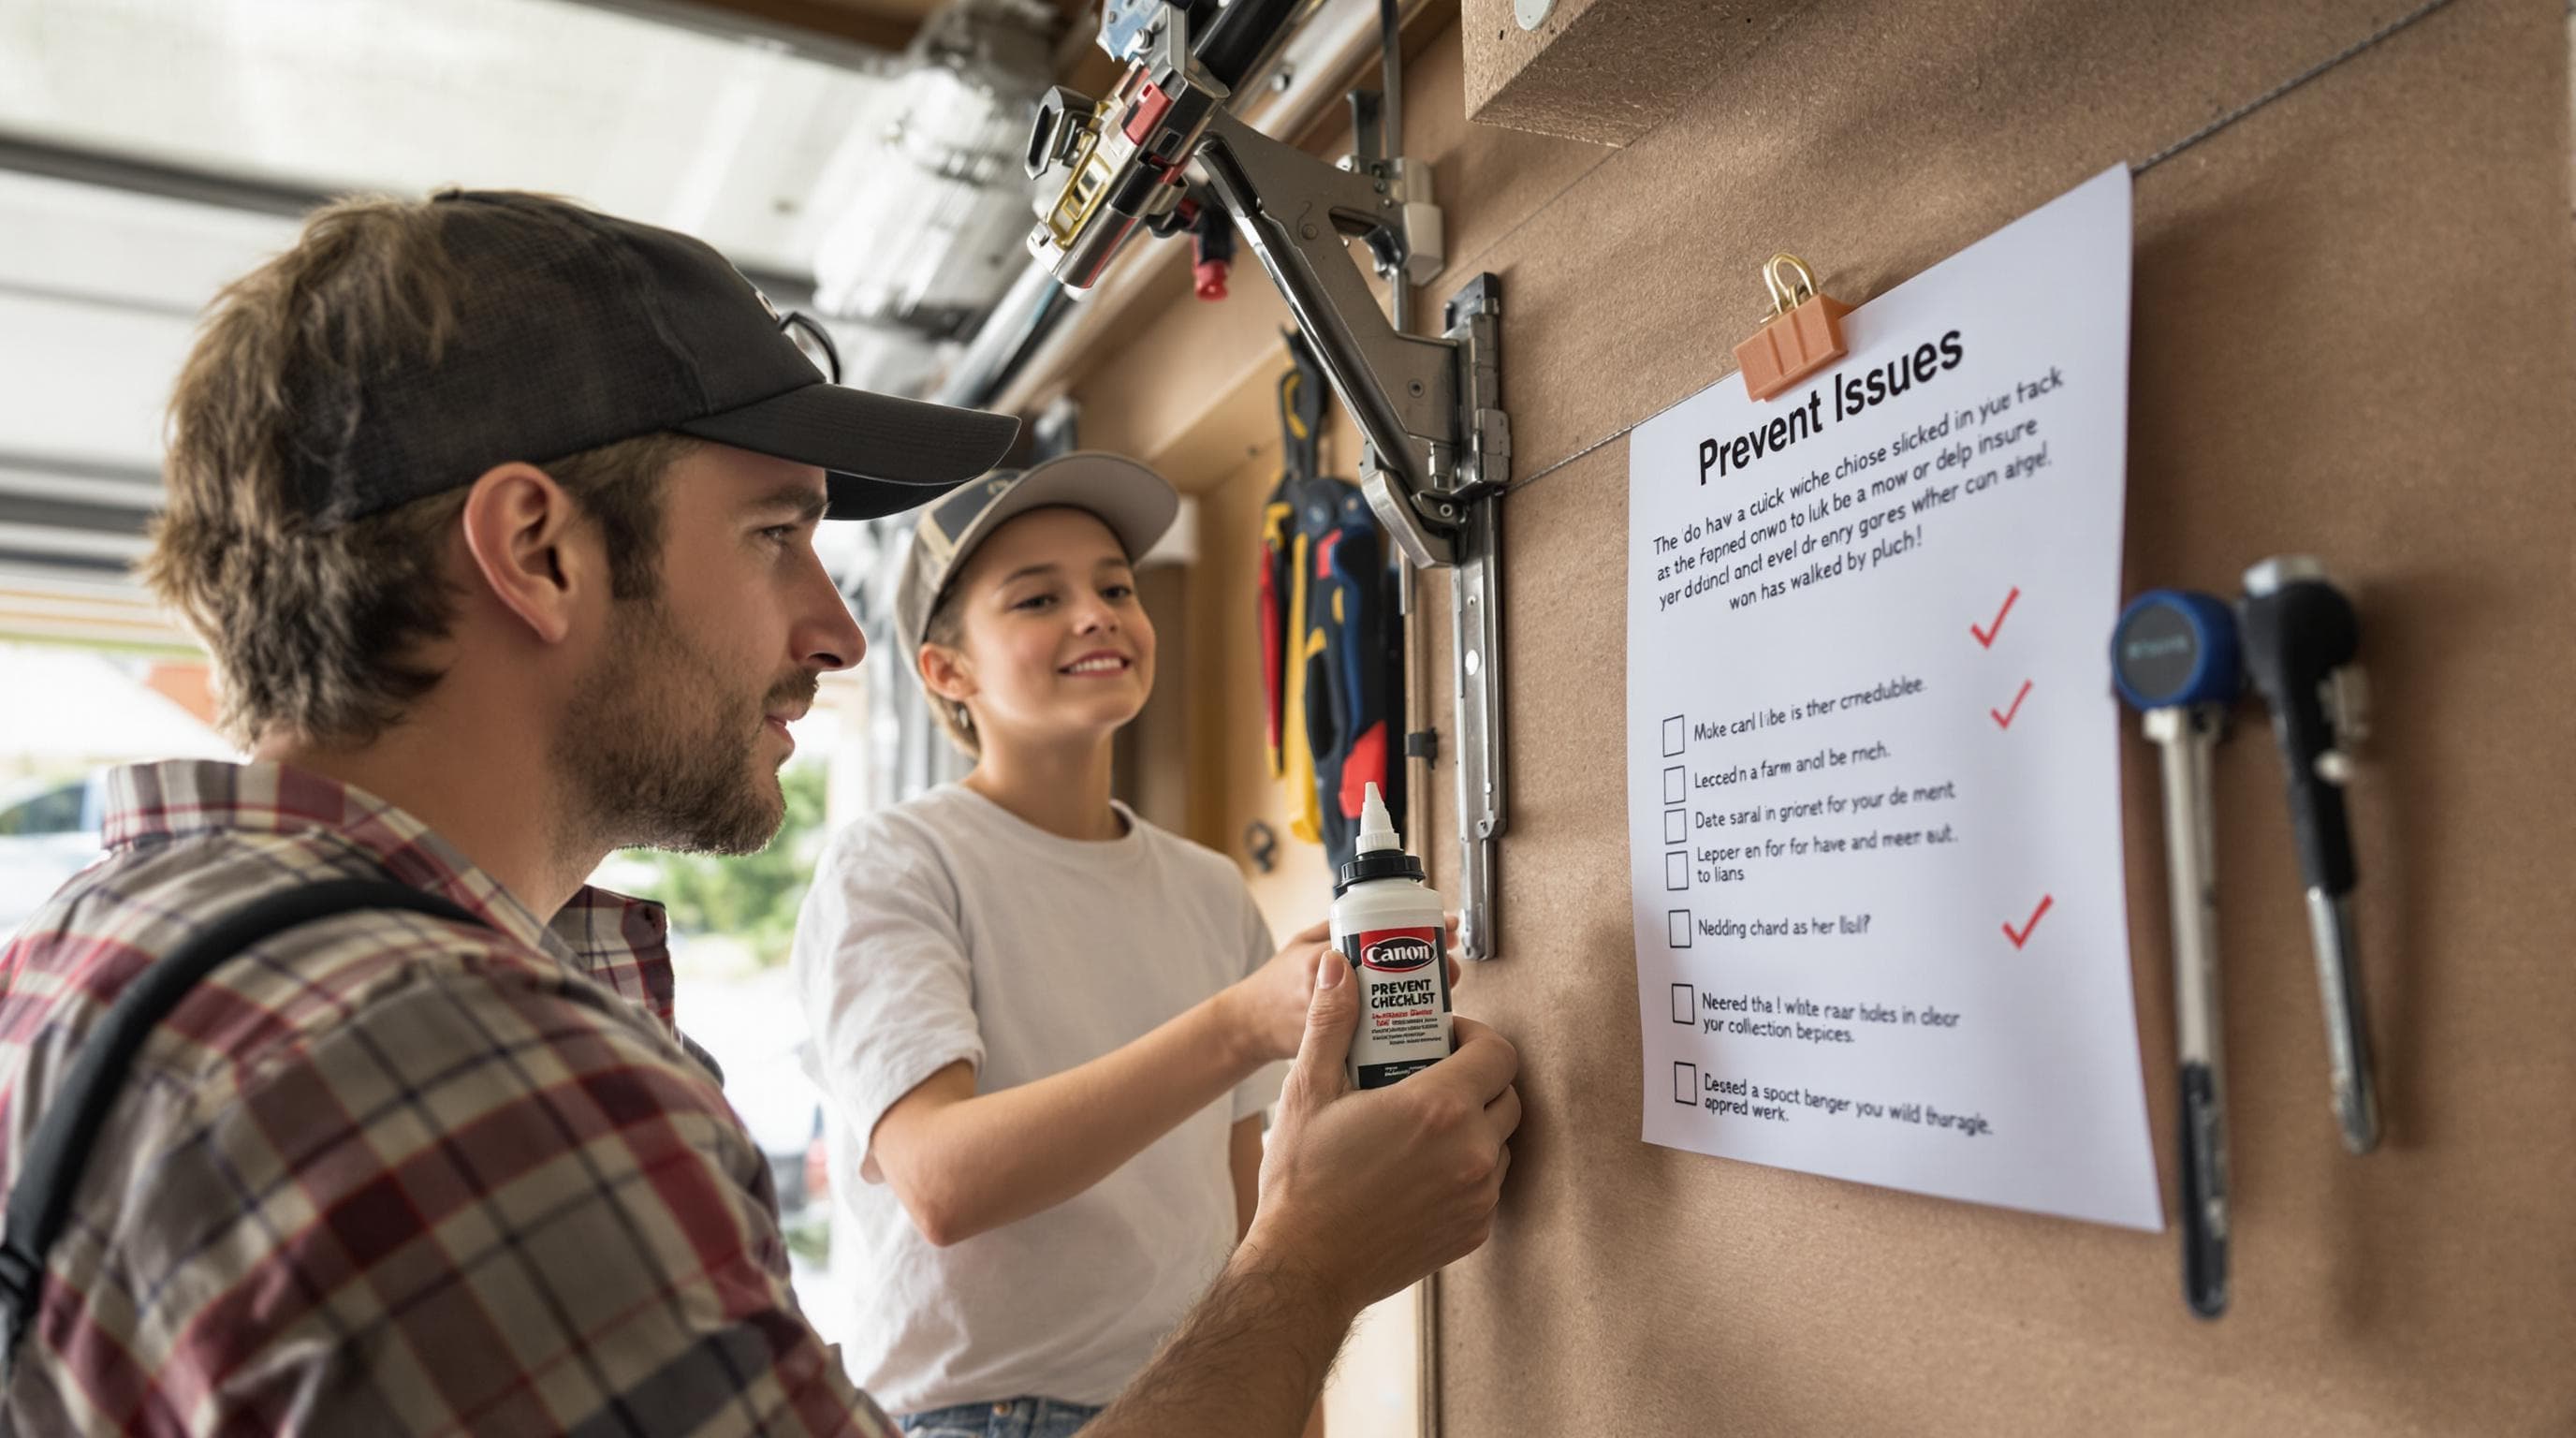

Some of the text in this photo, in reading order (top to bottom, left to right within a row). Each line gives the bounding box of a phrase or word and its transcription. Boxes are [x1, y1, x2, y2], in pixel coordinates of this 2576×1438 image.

[1699, 330, 1964, 486] Prevent Issues
[1653, 536, 1678, 555] The
[1705, 512, 1733, 535] hav
[1737, 508, 1746, 522] a
[1790, 470, 1831, 499] wiche
[1835, 448, 1887, 480] chiose
[1892, 412, 1949, 457] slicked
[1674, 555, 1696, 575] the
[1791, 512, 1805, 528] to
[1833, 492, 1852, 512] be
[1857, 488, 1866, 504] a
[1871, 470, 1909, 497] mow
[1912, 462, 1930, 481] or
[1978, 418, 2039, 456] insure
[1761, 580, 1787, 601] has
[1790, 554, 1842, 590] walked
[1847, 550, 1867, 572] by
[1791, 704, 1803, 721] is
[1806, 698, 1837, 717] ther
[1829, 747, 1848, 767] be
[1764, 805, 1777, 821] in
[1827, 794, 1848, 814] for
[1852, 793, 1884, 814] your
[1765, 838, 1786, 858] for
[1697, 869, 1711, 883] to
[1698, 918, 1747, 939] Nedding
[1749, 917, 1789, 936] chard
[1793, 922, 1808, 935] as
[1367, 945, 1430, 962] Canon
[1371, 978, 1432, 996] PREVENT
[1702, 992, 1748, 1012] Neered
[1902, 1005, 1916, 1024] in
[1751, 1085, 1760, 1098] a
[1855, 1101, 1884, 1119] you
